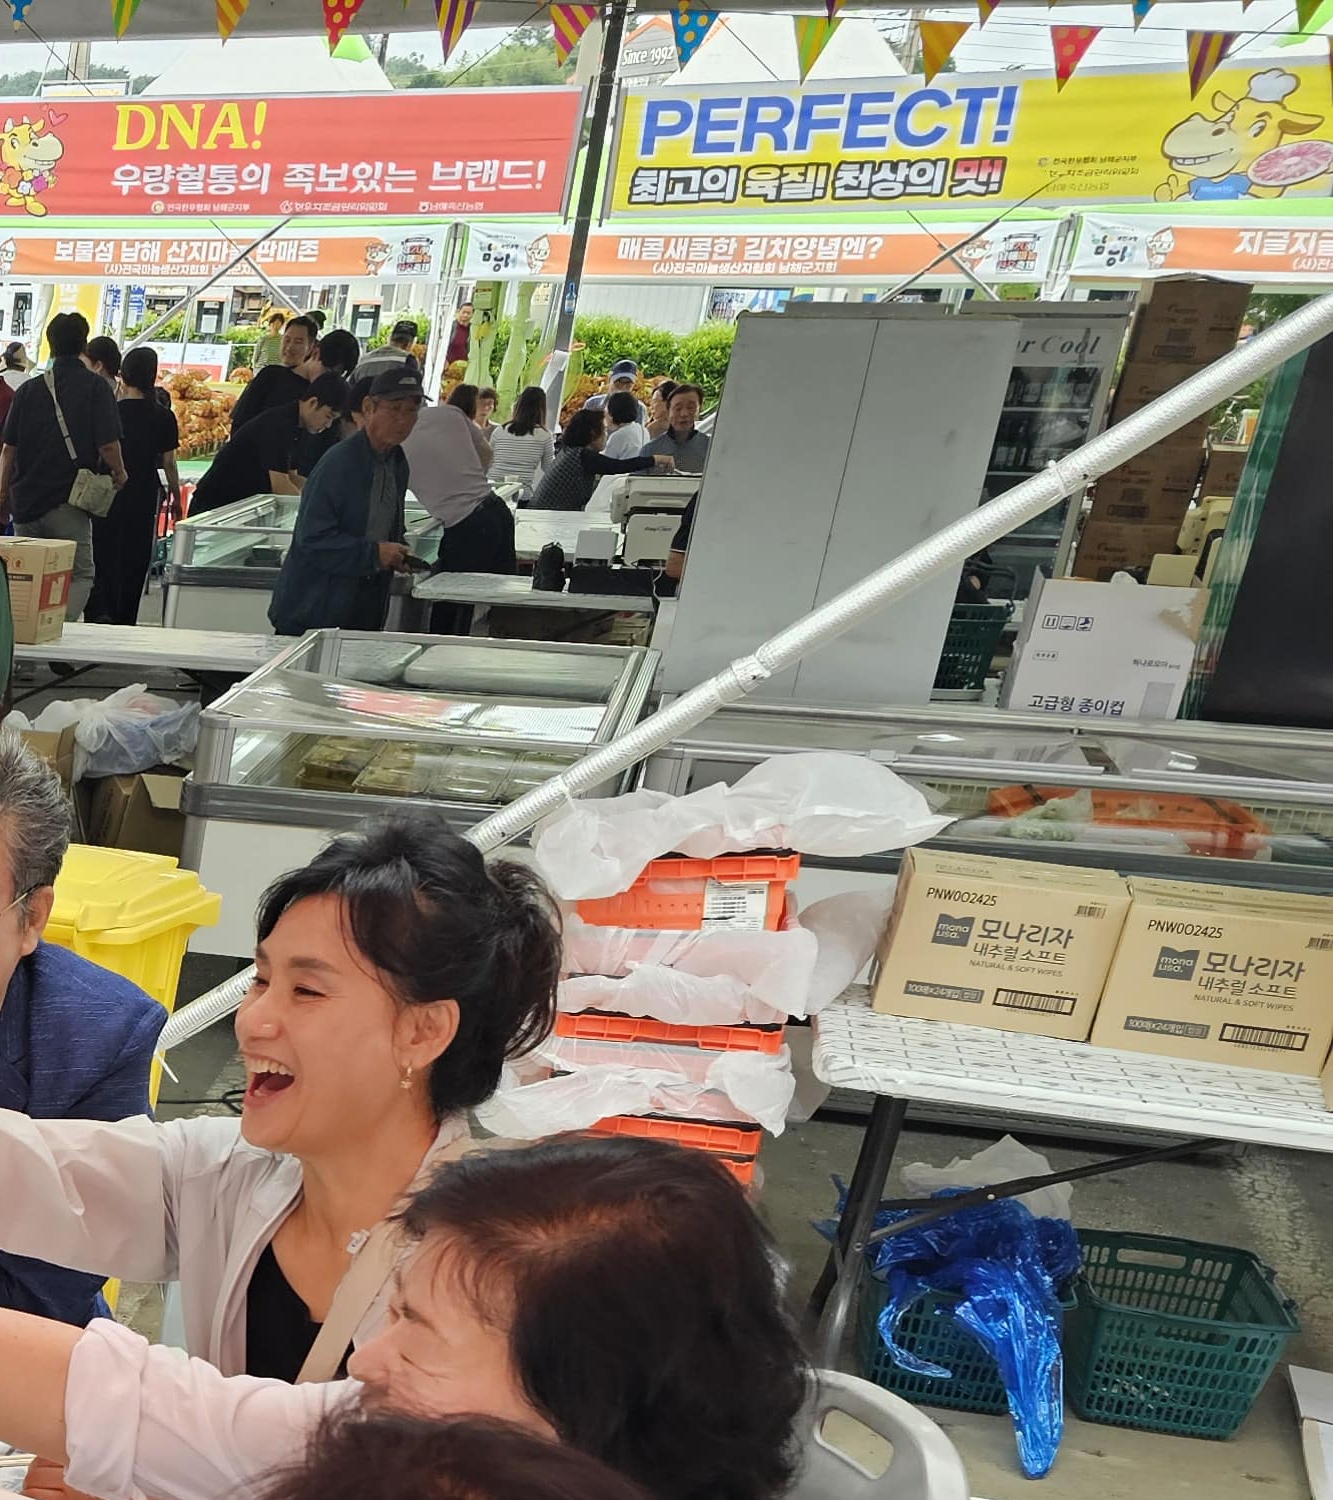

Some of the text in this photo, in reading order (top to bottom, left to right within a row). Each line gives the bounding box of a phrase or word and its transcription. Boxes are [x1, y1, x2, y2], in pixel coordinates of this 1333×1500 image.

[622, 46, 674, 66] Since 1992
[112, 101, 269, 151] DNA!
[640, 85, 1019, 156] PERFECT!
[111, 159, 547, 196] 우량혈통의 족보있는 브랜드!
[632, 158, 1003, 203] 최고의 육질! 천상의 맛!
[53, 240, 115, 263] 보물섬
[120, 240, 162, 263] 남해
[256, 239, 320, 263] 판매존
[617, 236, 884, 261] 매콤새콤한 김치양념엔?
[1028, 694, 1126, 717] 고급형 종이컵
[937, 922, 970, 934] mona
[977, 918, 1075, 949] 모나리자
[973, 942, 1067, 964] 내추럴 소프트
[1160, 956, 1194, 967] mona
[969, 959, 1006, 971] NATURAL
[1014, 964, 1036, 976] SOFT
[1036, 967, 1063, 978] WIPES
[1202, 951, 1307, 982] 모나리자
[1198, 976, 1298, 999] 내추럴 소프트
[1194, 993, 1232, 1006] NATURAL
[1242, 999, 1265, 1009] SOFT
[1266, 1001, 1294, 1013] WIPES
